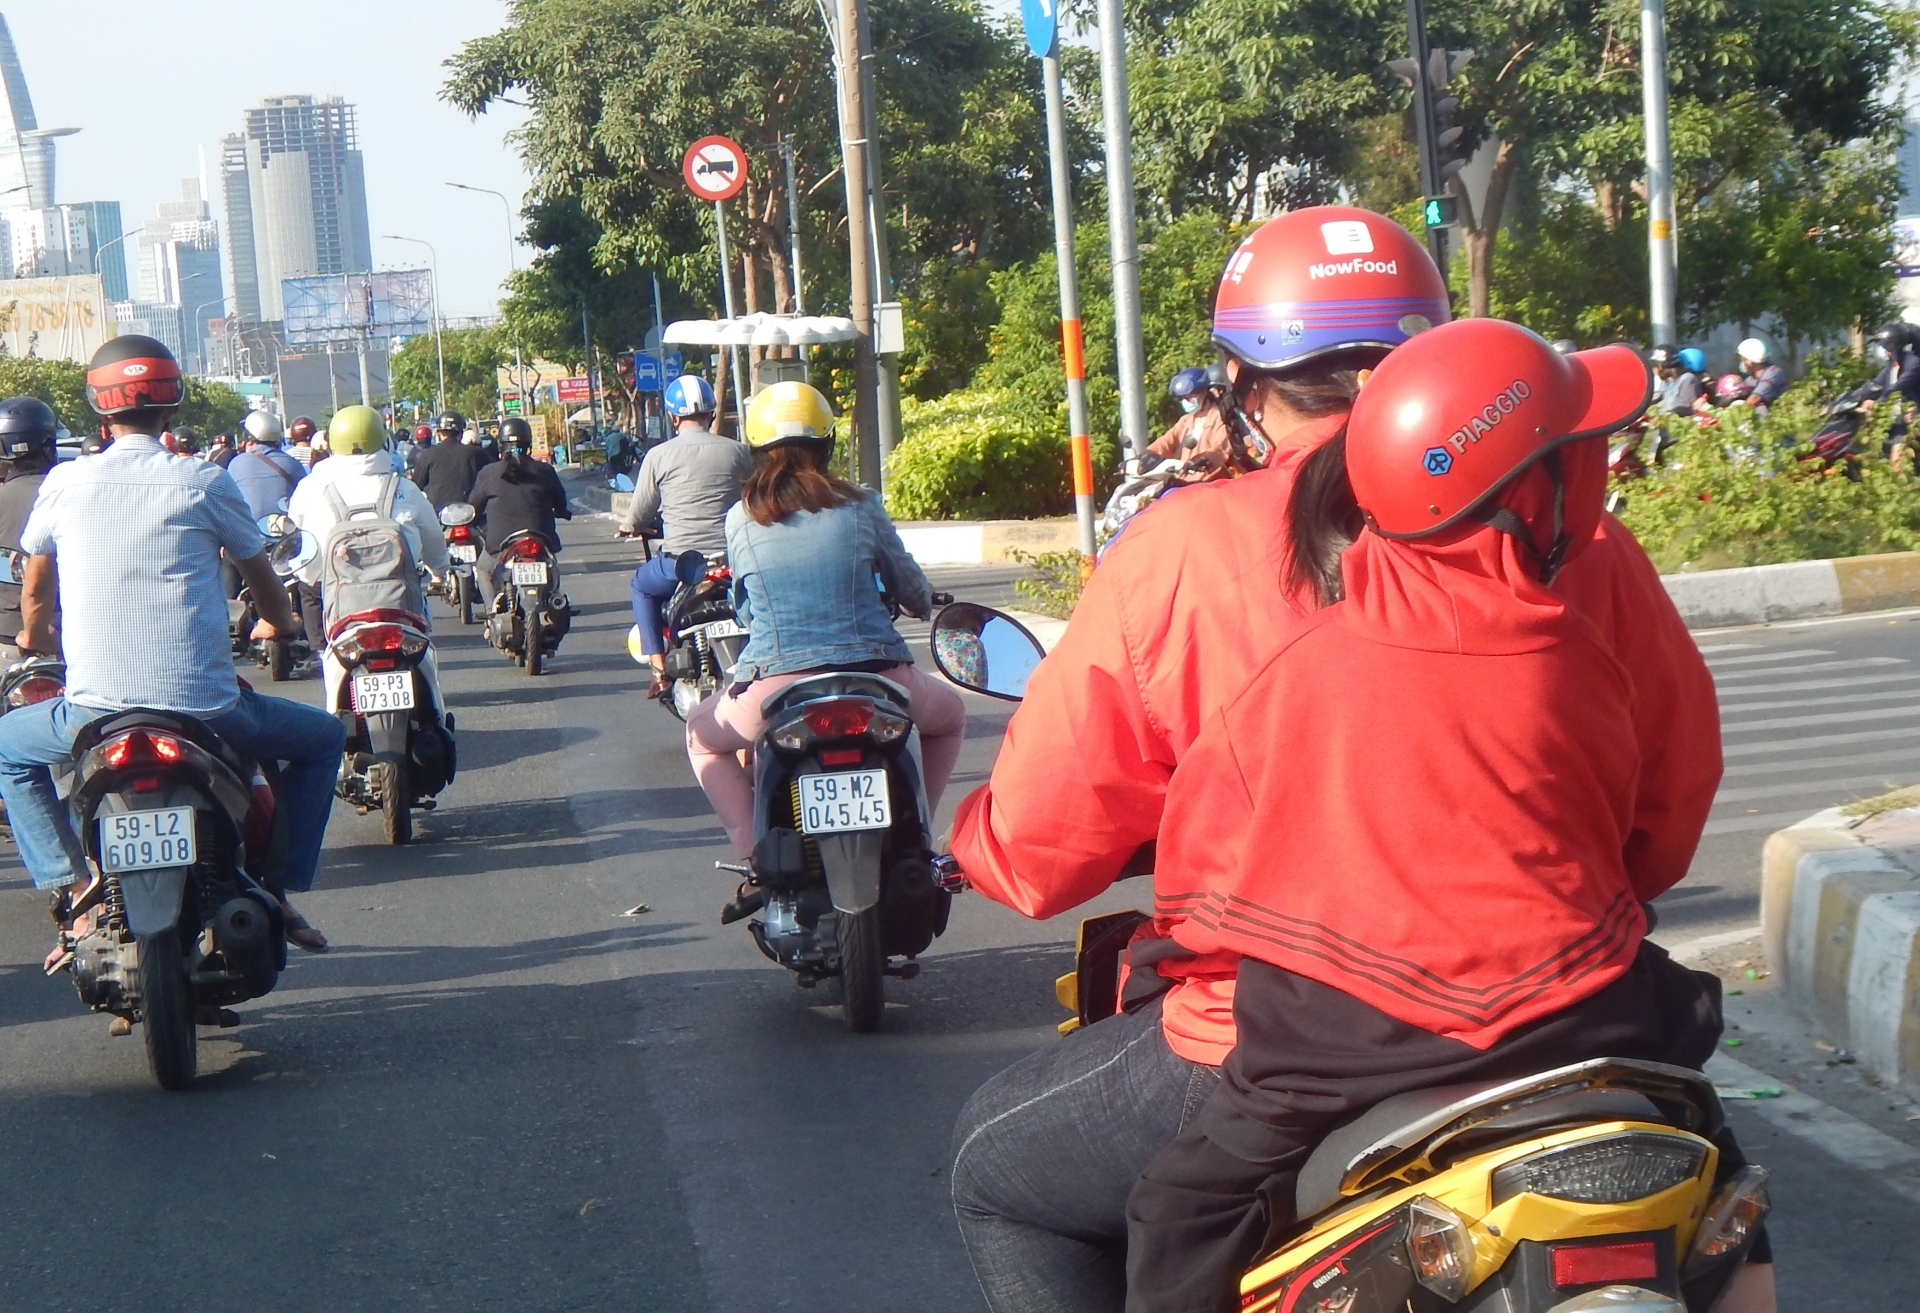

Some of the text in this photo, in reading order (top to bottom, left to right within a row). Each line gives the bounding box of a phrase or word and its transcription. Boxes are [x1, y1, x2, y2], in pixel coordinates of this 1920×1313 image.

[1309, 257, 1398, 280] NowFood
[127, 364, 145, 374] VIA
[1447, 378, 1532, 454] PIAGGIO
[517, 563, 542, 573] 54-T2
[518, 573, 543, 583] 6803
[363, 674, 404, 692] 59-P3
[360, 691, 411, 709] 073.08
[813, 775, 875, 802] 59-M2
[115, 812, 180, 840] 59-L2
[808, 800, 885, 829] 045.45
[108, 838, 189, 868] 609.08
